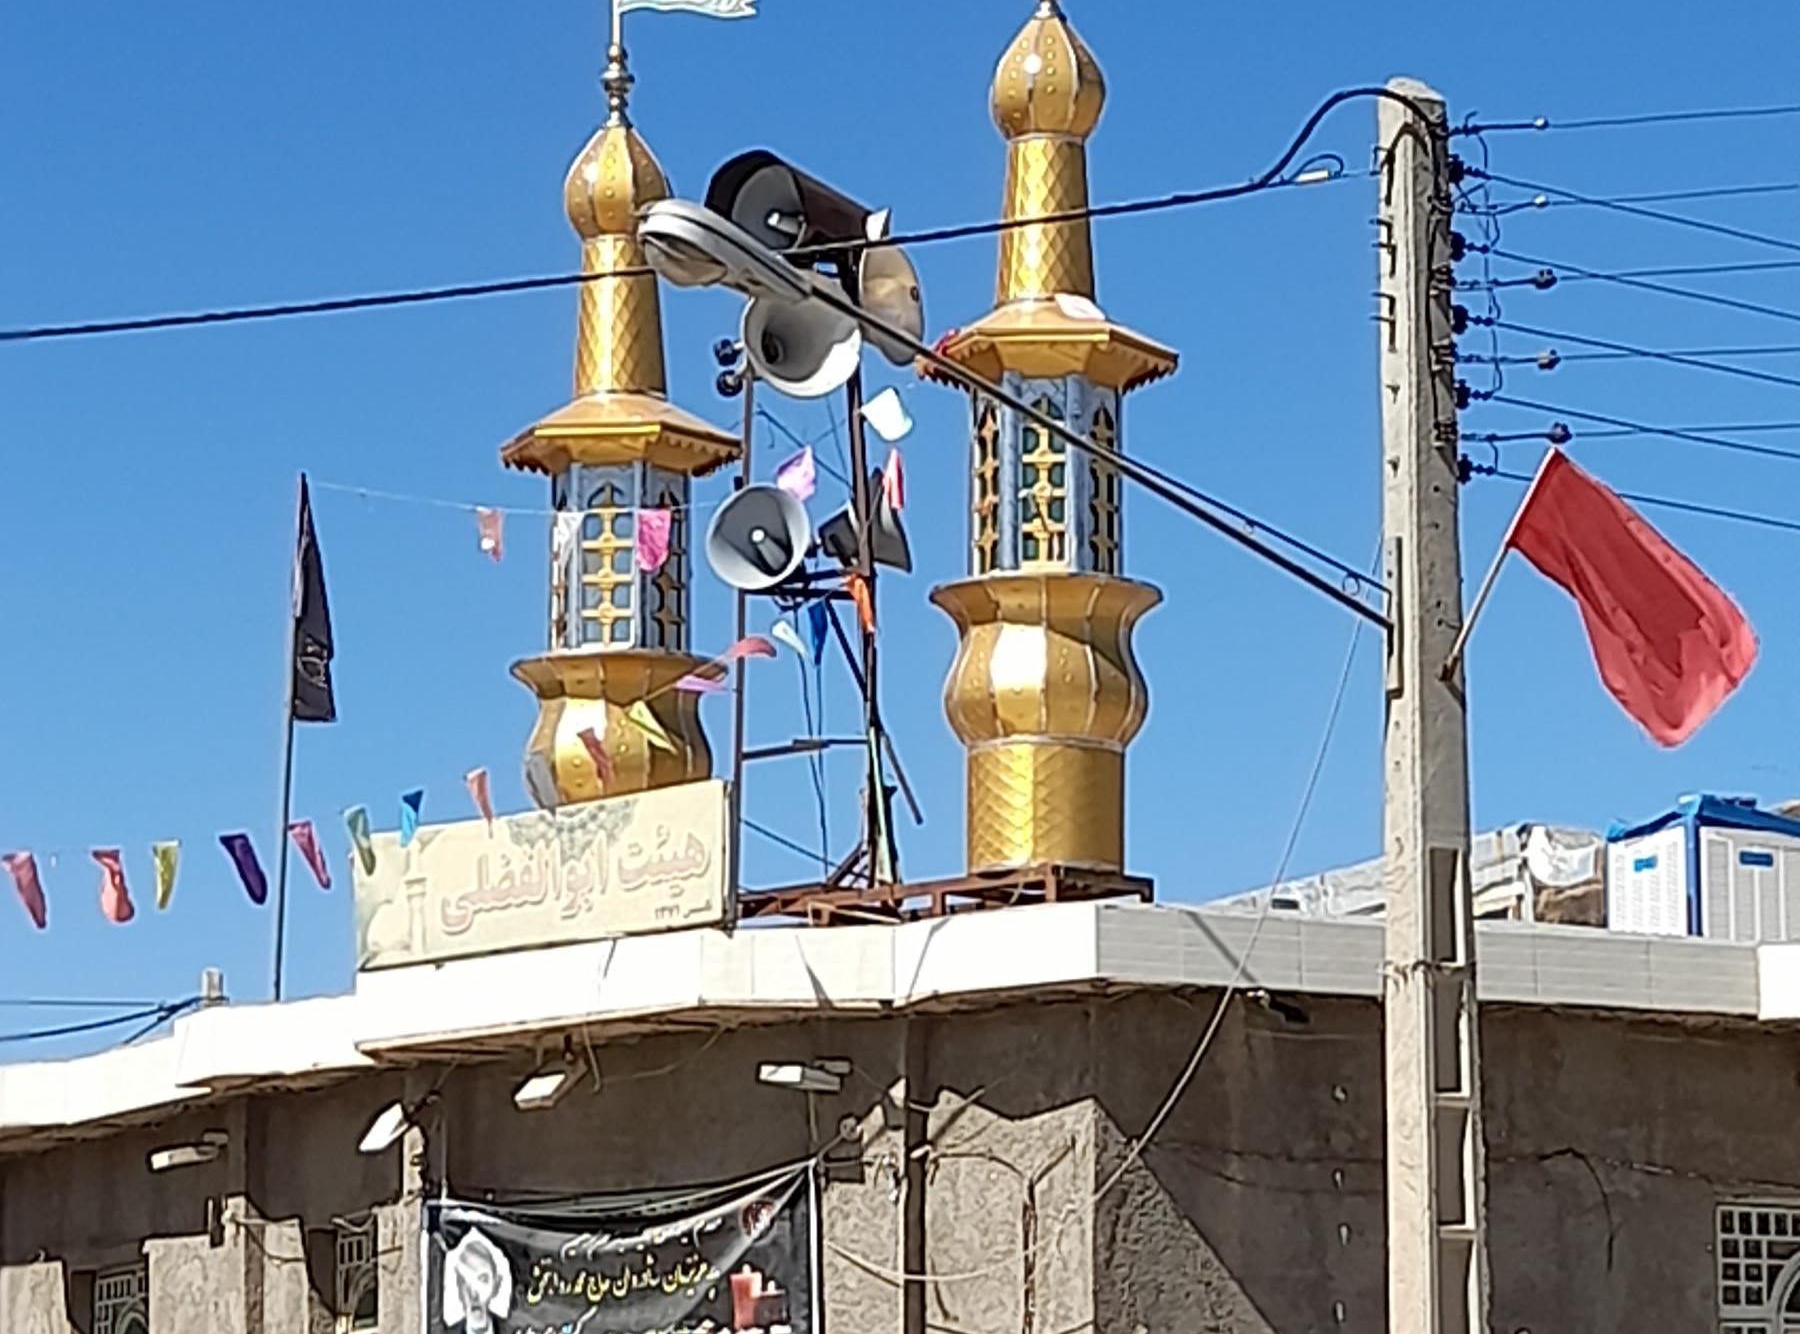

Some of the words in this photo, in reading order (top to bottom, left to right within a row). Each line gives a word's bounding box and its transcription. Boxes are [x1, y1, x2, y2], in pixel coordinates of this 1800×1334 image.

[440, 830, 609, 935] ابوالفضلی
[617, 824, 713, 898] هیئت
[587, 1273, 610, 1303] حاج
